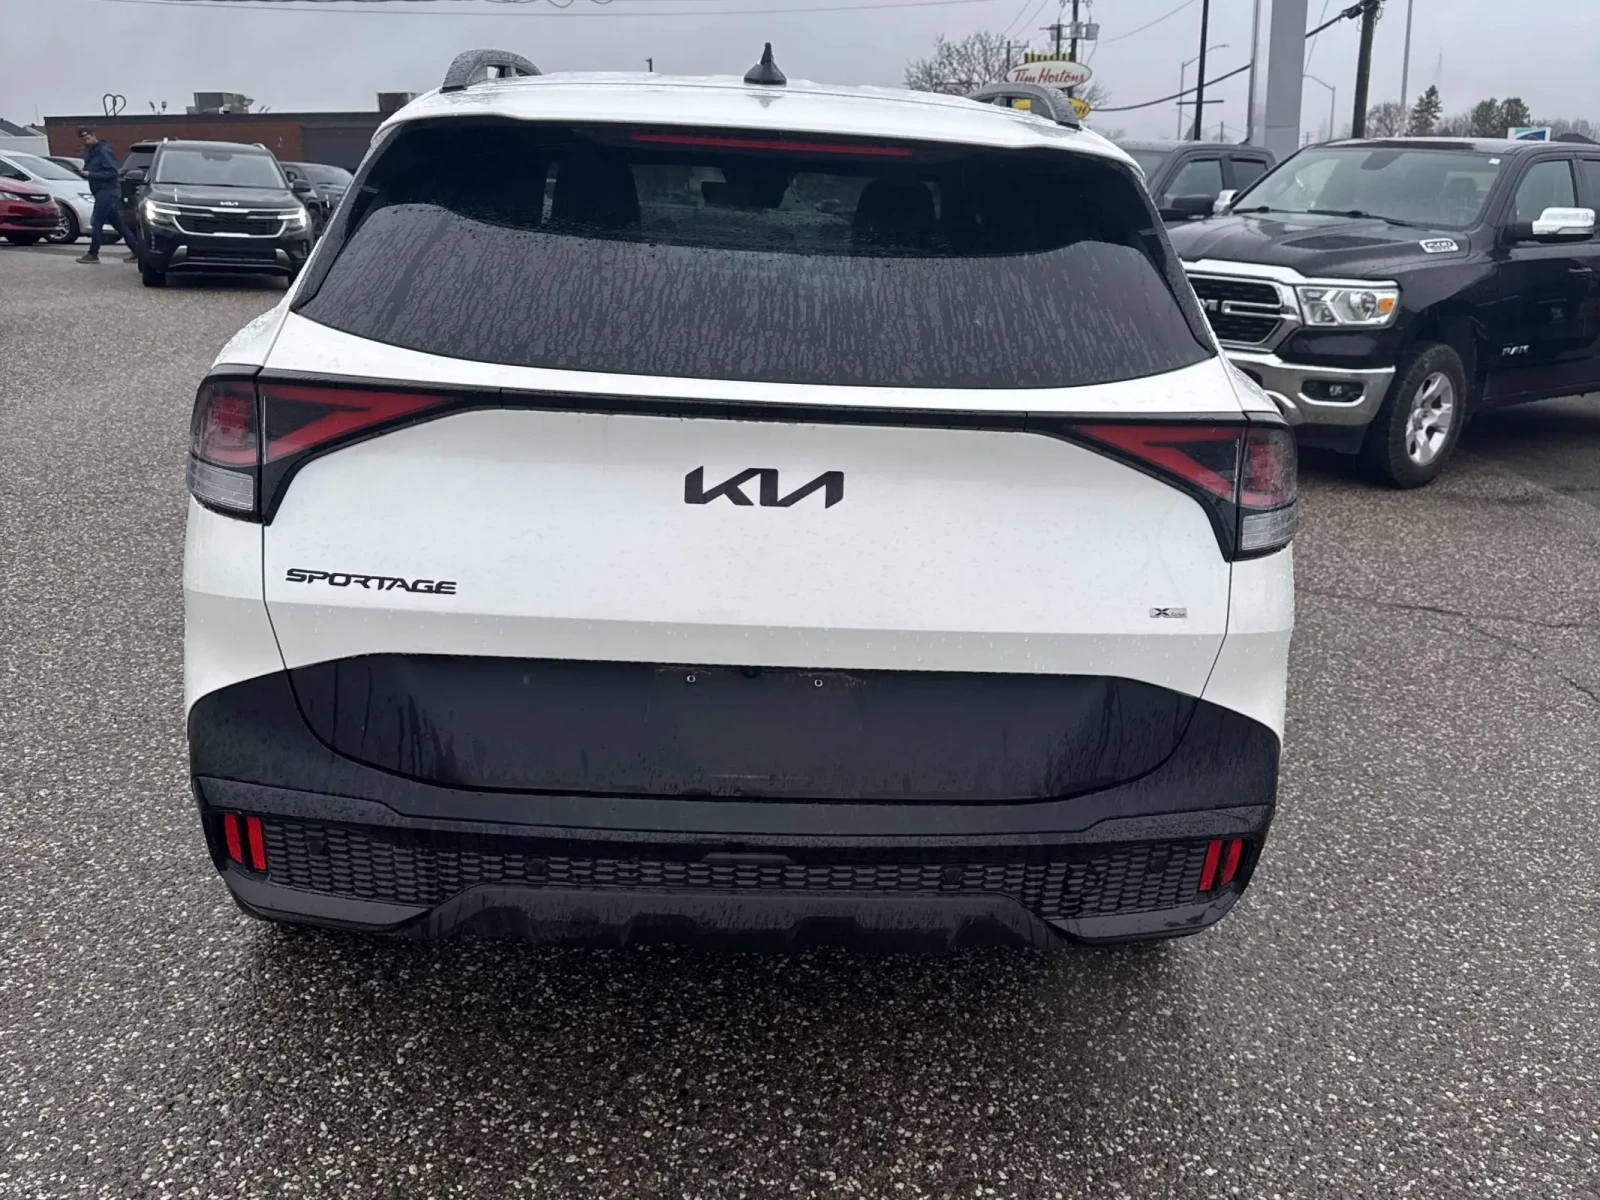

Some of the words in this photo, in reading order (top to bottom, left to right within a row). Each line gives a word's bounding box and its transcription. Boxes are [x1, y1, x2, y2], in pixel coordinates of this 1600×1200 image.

[1014, 68, 1036, 83] Tim
[1038, 67, 1084, 84] Hortons
[684, 465, 844, 509] KIA
[285, 568, 457, 595] SPORTAGE
